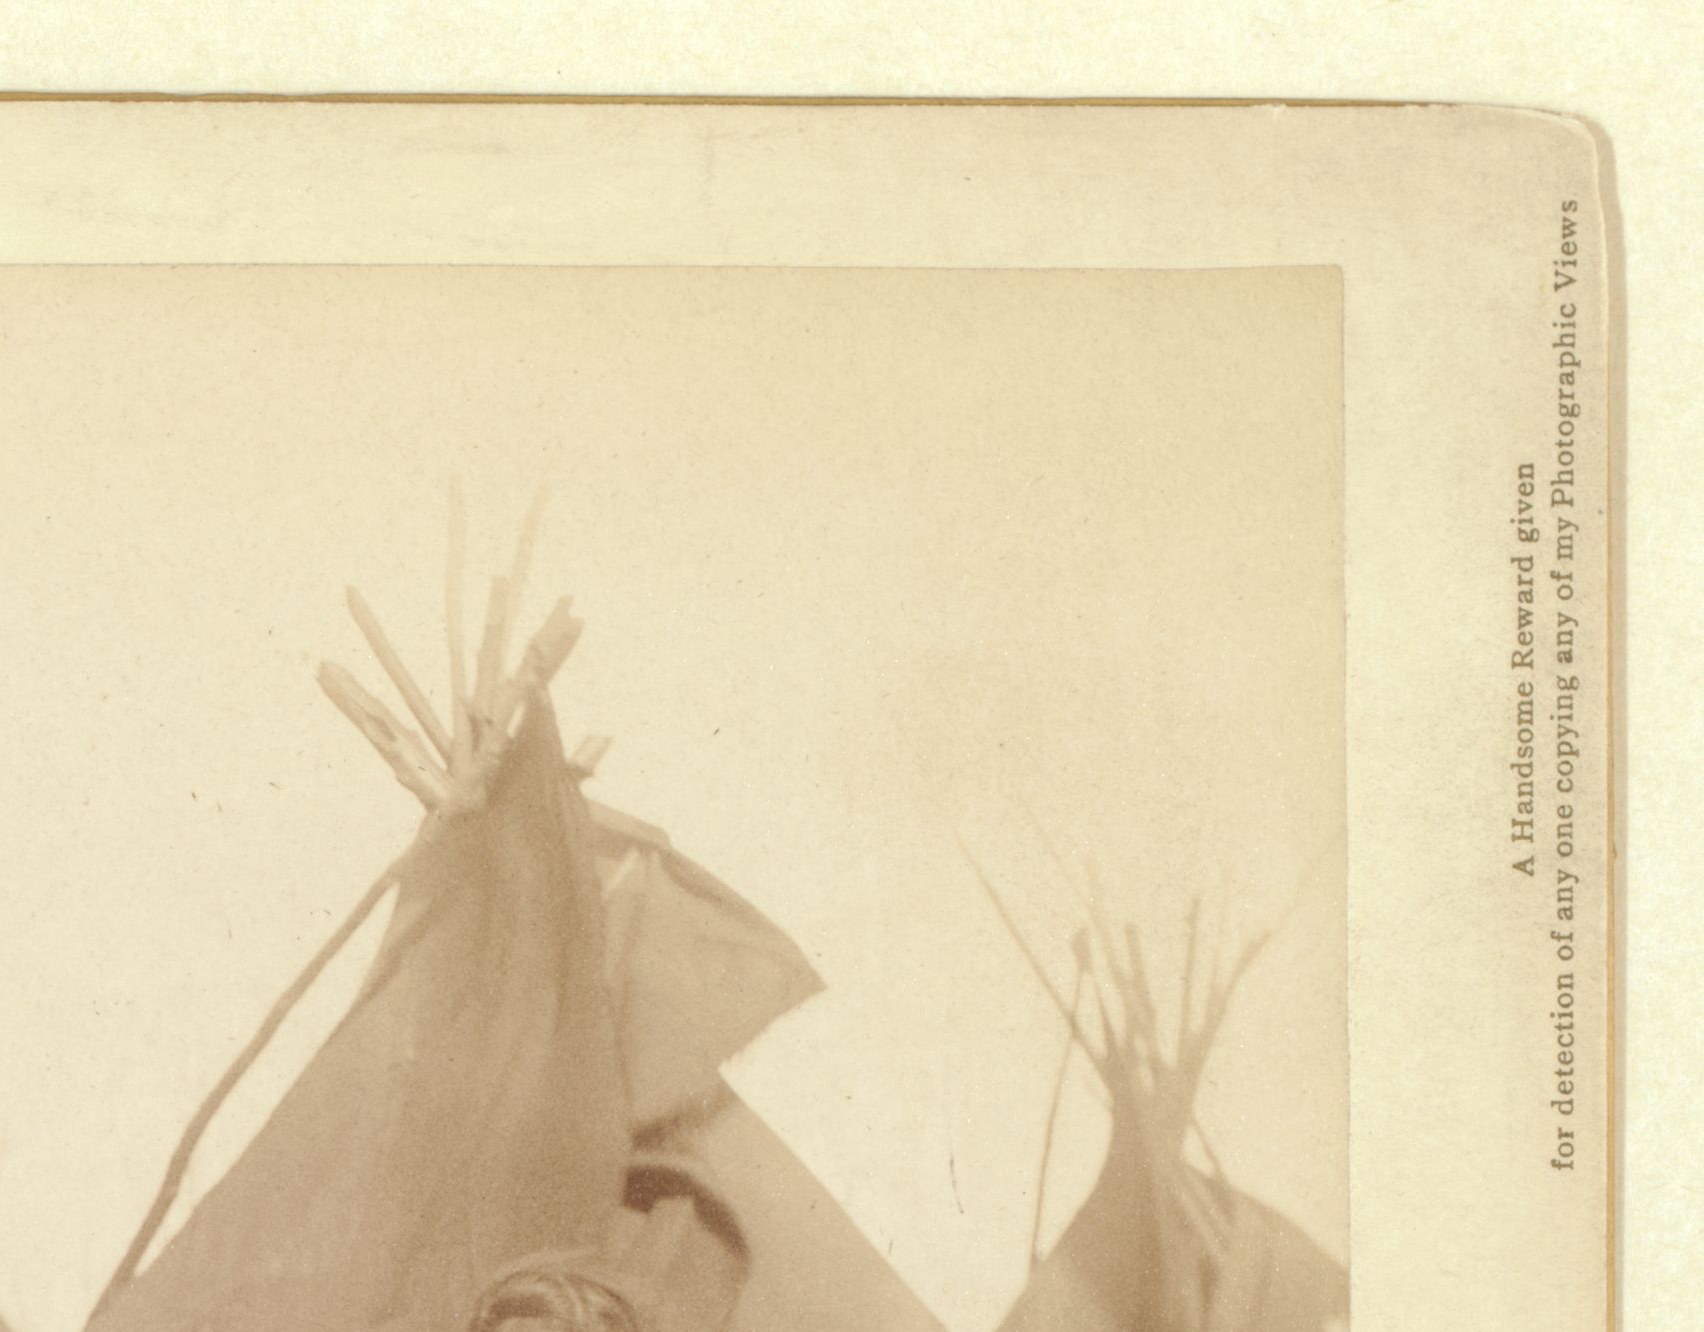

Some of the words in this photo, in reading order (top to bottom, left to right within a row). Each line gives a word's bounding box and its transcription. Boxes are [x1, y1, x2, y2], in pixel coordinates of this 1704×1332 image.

[1553, 200, 1578, 292] Views
[1550, 303, 1581, 508] Photographic
[1510, 462, 1540, 543] given
[1557, 517, 1579, 561] my
[1510, 555, 1534, 670] Reward
[1549, 570, 1574, 601] of
[1556, 612, 1579, 664] any
[1550, 675, 1580, 793] copying
[1509, 682, 1534, 843] Handsome
[1556, 804, 1574, 859] one
[1511, 855, 1535, 877] A
[1557, 868, 1580, 921] any
[1550, 930, 1574, 961] of
[1549, 972, 1575, 1116] detection
[1550, 1126, 1575, 1171] for
